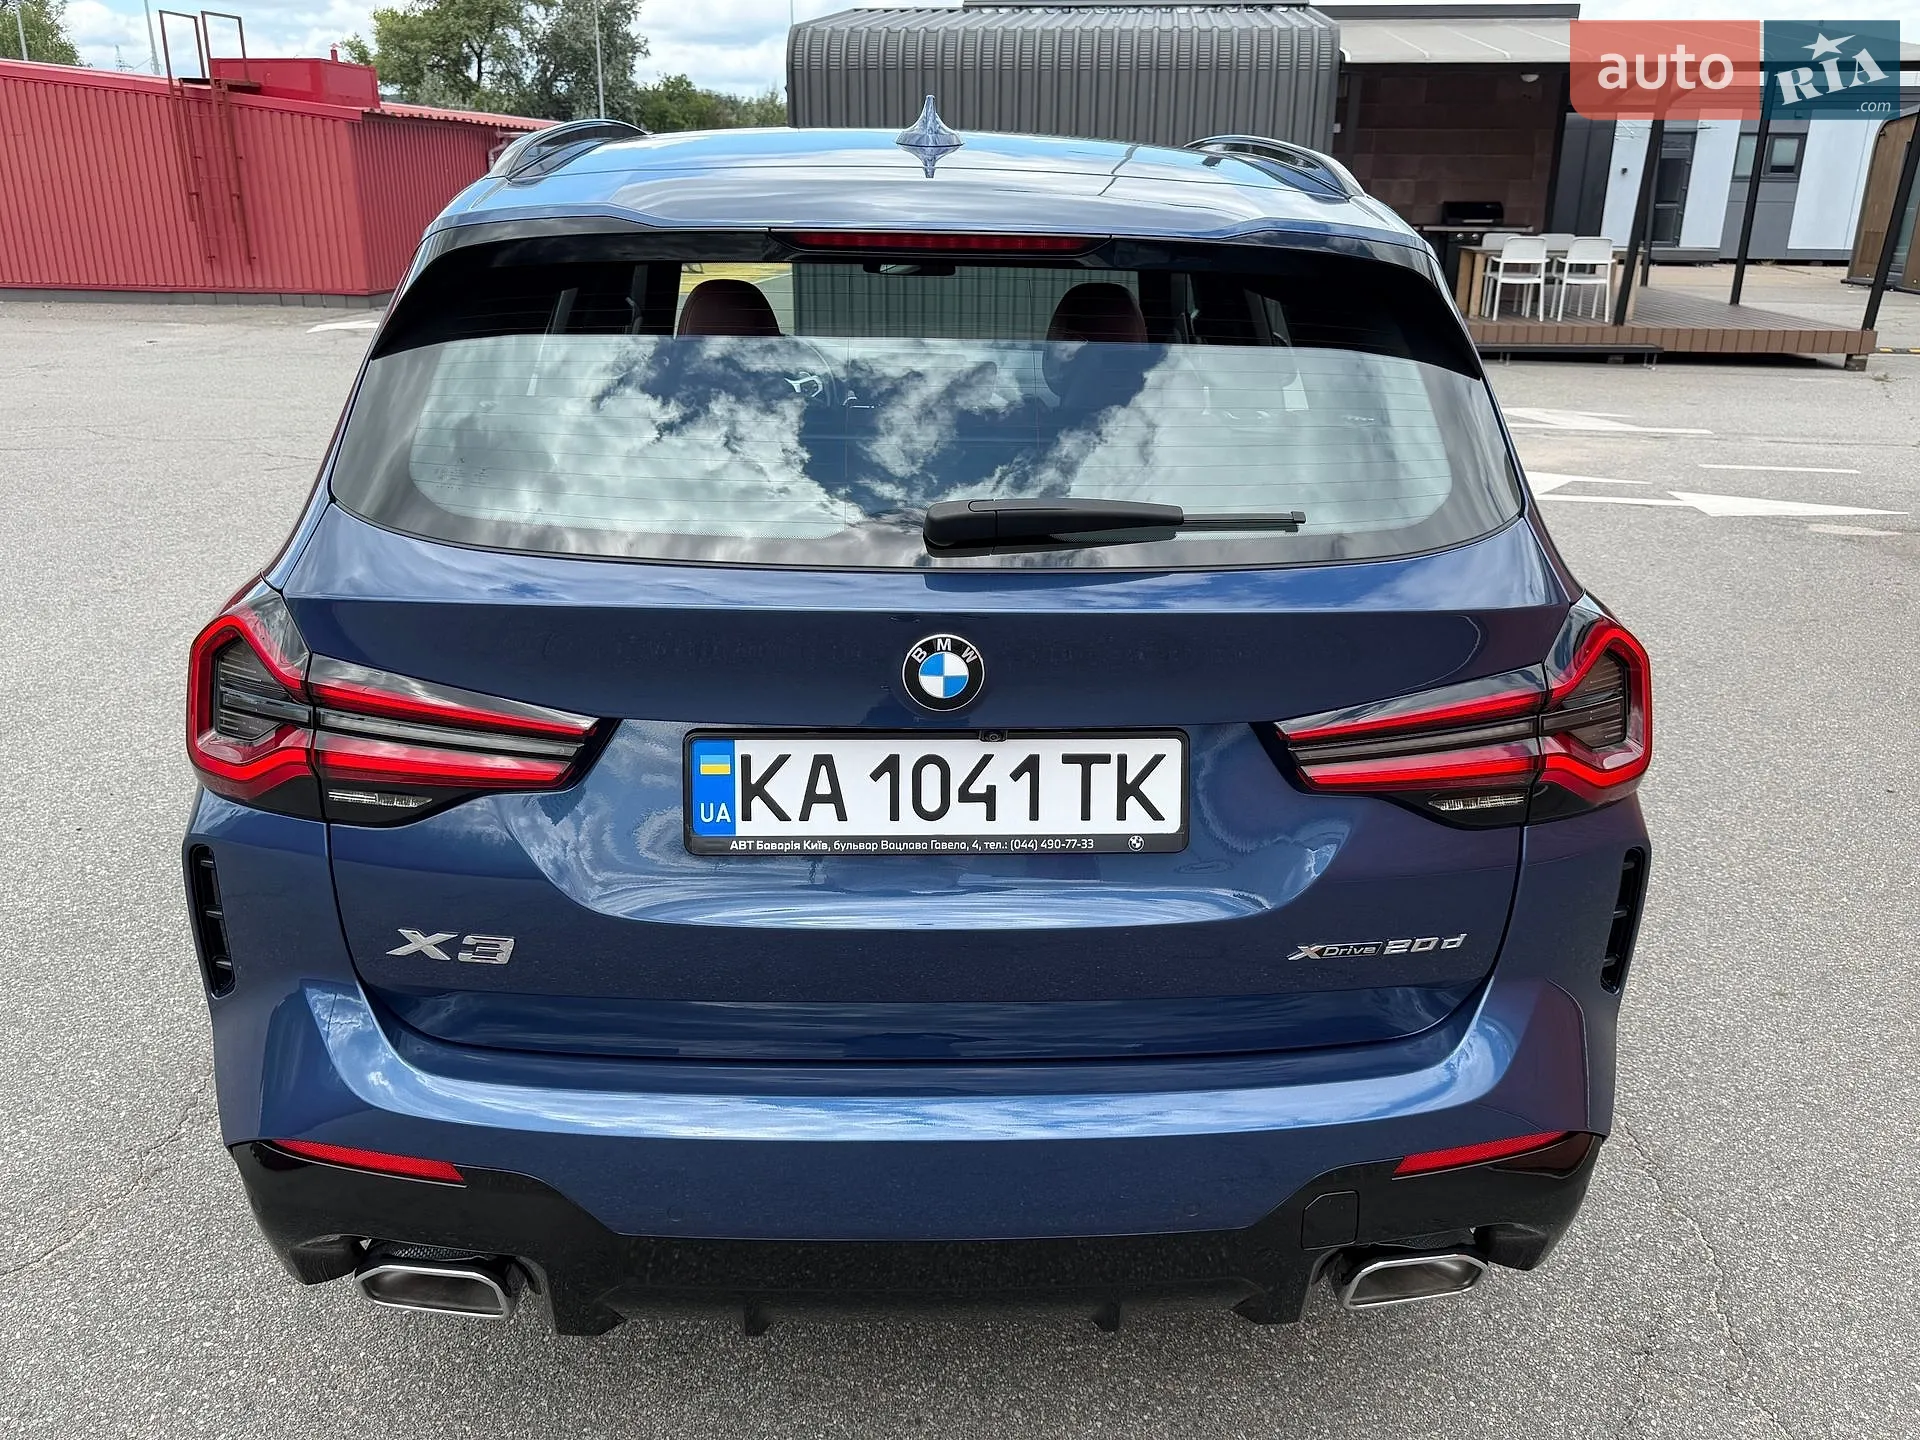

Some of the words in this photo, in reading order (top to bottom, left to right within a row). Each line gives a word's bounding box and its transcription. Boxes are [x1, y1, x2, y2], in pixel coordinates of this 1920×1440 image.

[911, 638, 978, 664] BMW
[740, 753, 848, 822] KA
[868, 753, 1040, 822] 1041
[1061, 753, 1167, 822] TK
[700, 802, 732, 823] UA
[803, 840, 831, 851] Київ,
[833, 840, 878, 852] бульвар
[972, 839, 982, 851] 4,
[1010, 839, 1038, 851] (044)
[1040, 838, 1094, 850] 490-77-33
[385, 928, 515, 965] X3
